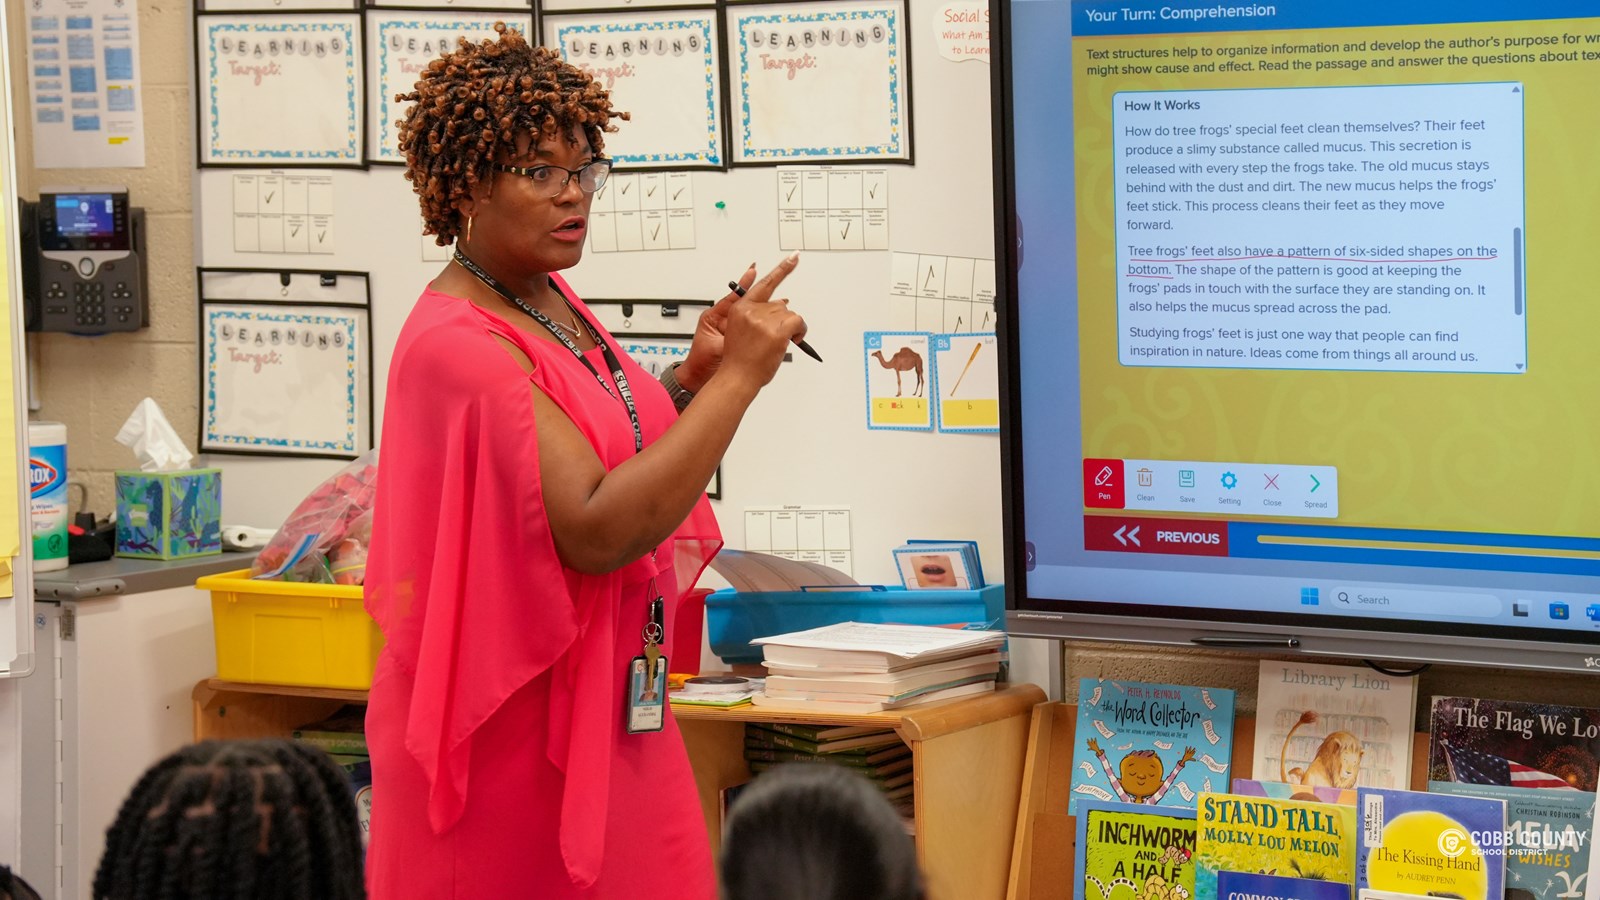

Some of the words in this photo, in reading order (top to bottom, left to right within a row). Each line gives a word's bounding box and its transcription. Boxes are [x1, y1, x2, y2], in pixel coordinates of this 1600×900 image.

[944, 8, 980, 22] Social
[1086, 9, 1117, 22] Your
[1121, 8, 1156, 20] Turn:
[1160, 4, 1276, 21] Comprehension
[752, 26, 882, 48] LEARNING
[942, 30, 966, 39] What
[968, 30, 983, 40] Am
[221, 38, 341, 54] LEARNING
[572, 36, 698, 57] LEARNING
[952, 46, 962, 54] to
[1086, 48, 1110, 60] Text
[1112, 48, 1169, 59] structures
[1172, 46, 1198, 59] help
[1201, 47, 1213, 56] to
[1216, 45, 1268, 58] organize
[1272, 42, 1339, 54] information
[1343, 41, 1366, 52] and
[1370, 40, 1420, 52] develop
[1424, 38, 1445, 49] the
[1449, 36, 1500, 48] author's
[1504, 36, 1558, 48] purpose
[1562, 33, 1581, 44] for
[759, 53, 817, 80] Target:
[1086, 64, 1119, 78] might
[1121, 64, 1152, 75] show
[1155, 65, 1190, 74] cause
[1193, 62, 1215, 72] and
[1218, 61, 1255, 72] effect.
[1259, 60, 1288, 70] Read
[1292, 59, 1312, 70] the
[1316, 60, 1367, 71] passage
[1371, 56, 1394, 68] and
[1398, 57, 1444, 66] answer
[1447, 54, 1468, 65] the
[1472, 52, 1535, 66] questions
[1540, 51, 1578, 62] about
[228, 60, 282, 86] Target:
[1124, 101, 1151, 111] How
[1154, 100, 1161, 110] It
[1164, 100, 1200, 110] Works
[1125, 126, 1152, 136] How
[1154, 125, 1170, 136] do
[1172, 126, 1196, 136] tree
[1199, 124, 1232, 138] frogs'
[1236, 124, 1276, 136] special
[1280, 123, 1304, 134] feet
[1308, 123, 1340, 134] clean
[1344, 120, 1420, 132] themselves?
[1424, 120, 1456, 131] Their
[1460, 120, 1485, 130] feet
[222, 325, 342, 346] LEARNING
[1130, 326, 1179, 340] Studying
[1182, 328, 1215, 340] frogs'
[1218, 328, 1241, 338] feet
[1244, 328, 1254, 339] is
[1256, 328, 1278, 341] just
[1281, 331, 1304, 340] one
[1308, 332, 1332, 342] way
[1335, 330, 1358, 340] that
[1362, 330, 1405, 343] people
[1409, 333, 1431, 341] can
[1435, 331, 1458, 342] find
[938, 339, 949, 348] Bb
[228, 347, 282, 374] Target:
[967, 401, 973, 410] b
[1098, 492, 1111, 500] Pen
[1136, 493, 1155, 502] Clean
[1179, 495, 1196, 503] Save
[1218, 497, 1242, 506] Setting
[1263, 498, 1282, 507] Close
[1304, 500, 1328, 509] Spread
[1156, 530, 1220, 544] PREVIOUS
[1357, 594, 1390, 606] Search
[1282, 668, 1346, 692] Library
[1352, 673, 1391, 691] Lion
[1127, 687, 1141, 698] PETER
[1153, 689, 1182, 700] REYNOLDS
[1101, 700, 1114, 712] the
[1114, 698, 1147, 726] Word
[1150, 701, 1200, 730] Collector
[1454, 706, 1489, 729] The
[1494, 710, 1534, 740] Flag
[1539, 714, 1567, 736] We
[1572, 717, 1600, 739] Lo
[1204, 797, 1278, 829] STAND
[1283, 808, 1342, 840] TALL,
[1516, 807, 1548, 817] CHRISTIAN
[1550, 809, 1581, 819] ROBINSON
[1098, 820, 1197, 852] INCHWORM
[1204, 827, 1254, 846] MOLLY
[1258, 833, 1286, 851] LOU
[1289, 837, 1339, 858] MELON
[1134, 850, 1157, 862] AND
[1377, 847, 1399, 863] The
[1403, 849, 1444, 870] Kissing
[1447, 855, 1480, 872] Hand
[1519, 853, 1571, 868] WISHES
[1112, 861, 1126, 878] A
[1132, 862, 1182, 884] HALF
[1396, 872, 1404, 880] by
[1405, 873, 1435, 883] AUDREY
[1436, 876, 1456, 885] PENN
